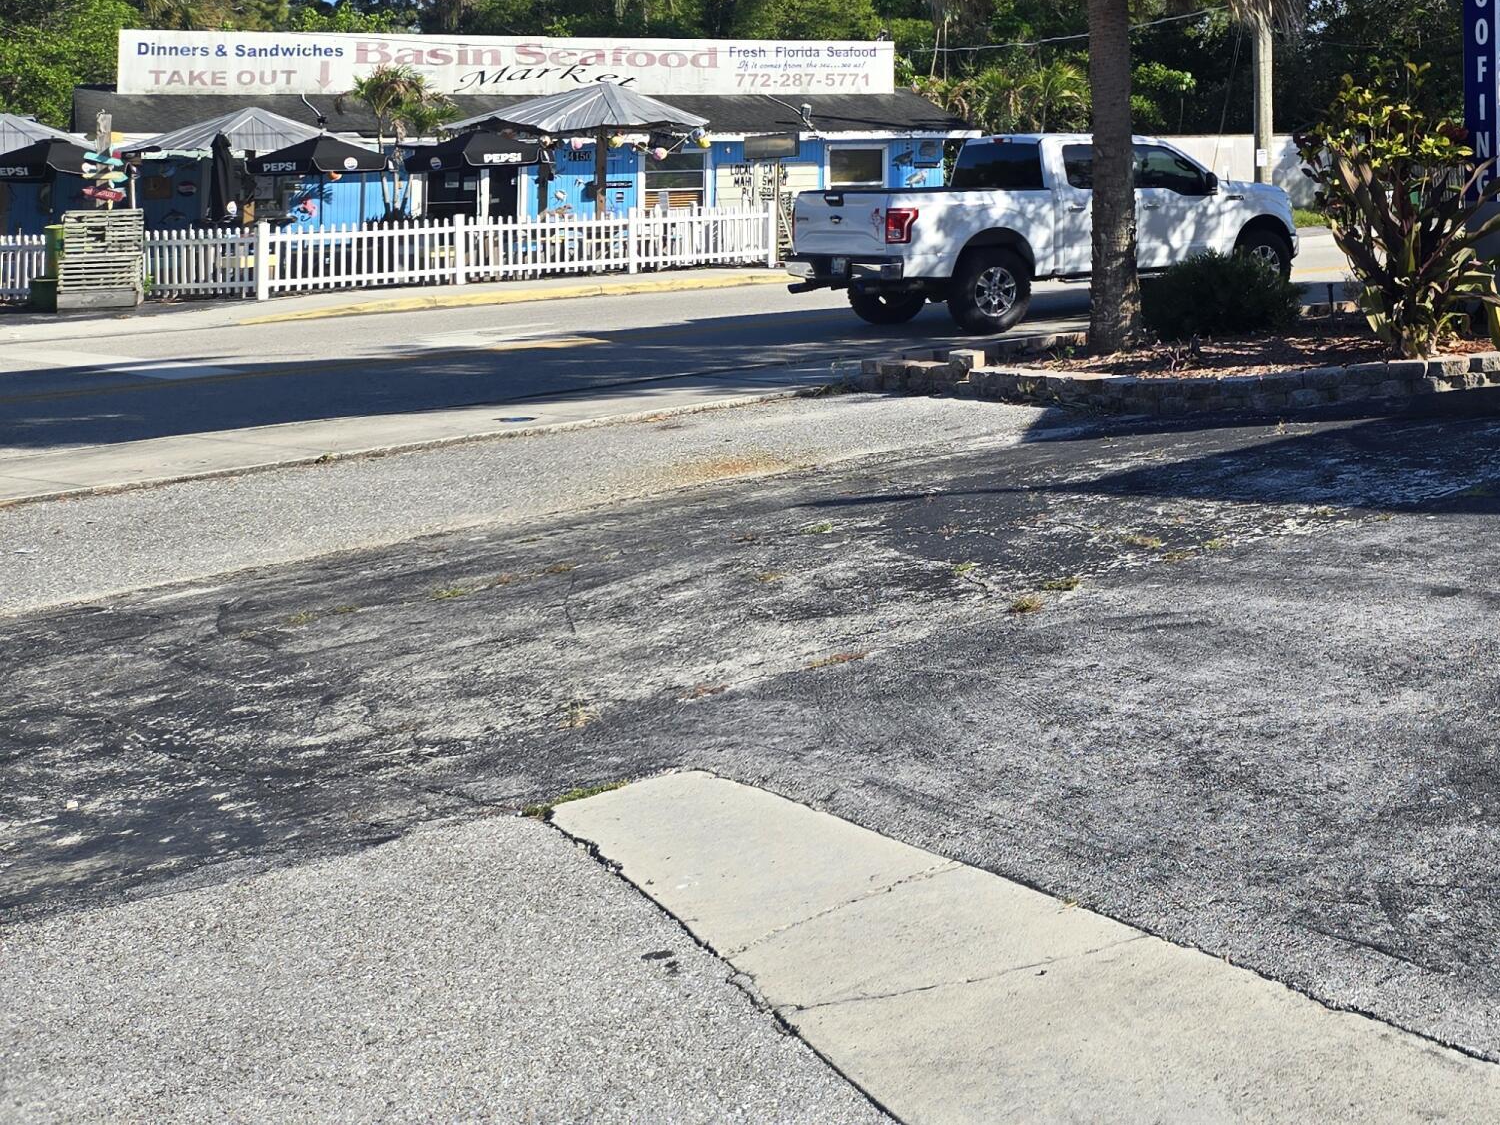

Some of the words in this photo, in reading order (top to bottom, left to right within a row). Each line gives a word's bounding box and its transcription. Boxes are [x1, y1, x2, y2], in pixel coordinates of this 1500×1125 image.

[137, 42, 210, 57] Dinners
[215, 44, 228, 57] &
[235, 44, 344, 58] Sandwiches
[354, 42, 501, 66] Basin
[515, 43, 720, 69] Seafood
[729, 47, 766, 58] Fresh
[775, 47, 820, 58] Florida
[827, 47, 877, 58] Seafood
[149, 69, 227, 87] TAKE
[236, 70, 297, 86] OUT
[454, 65, 639, 93] Market
[735, 73, 870, 88] 772-287-5771
[484, 153, 522, 163] PEPSI
[0, 167, 29, 176] EPSI
[263, 162, 296, 172] PEPSI
